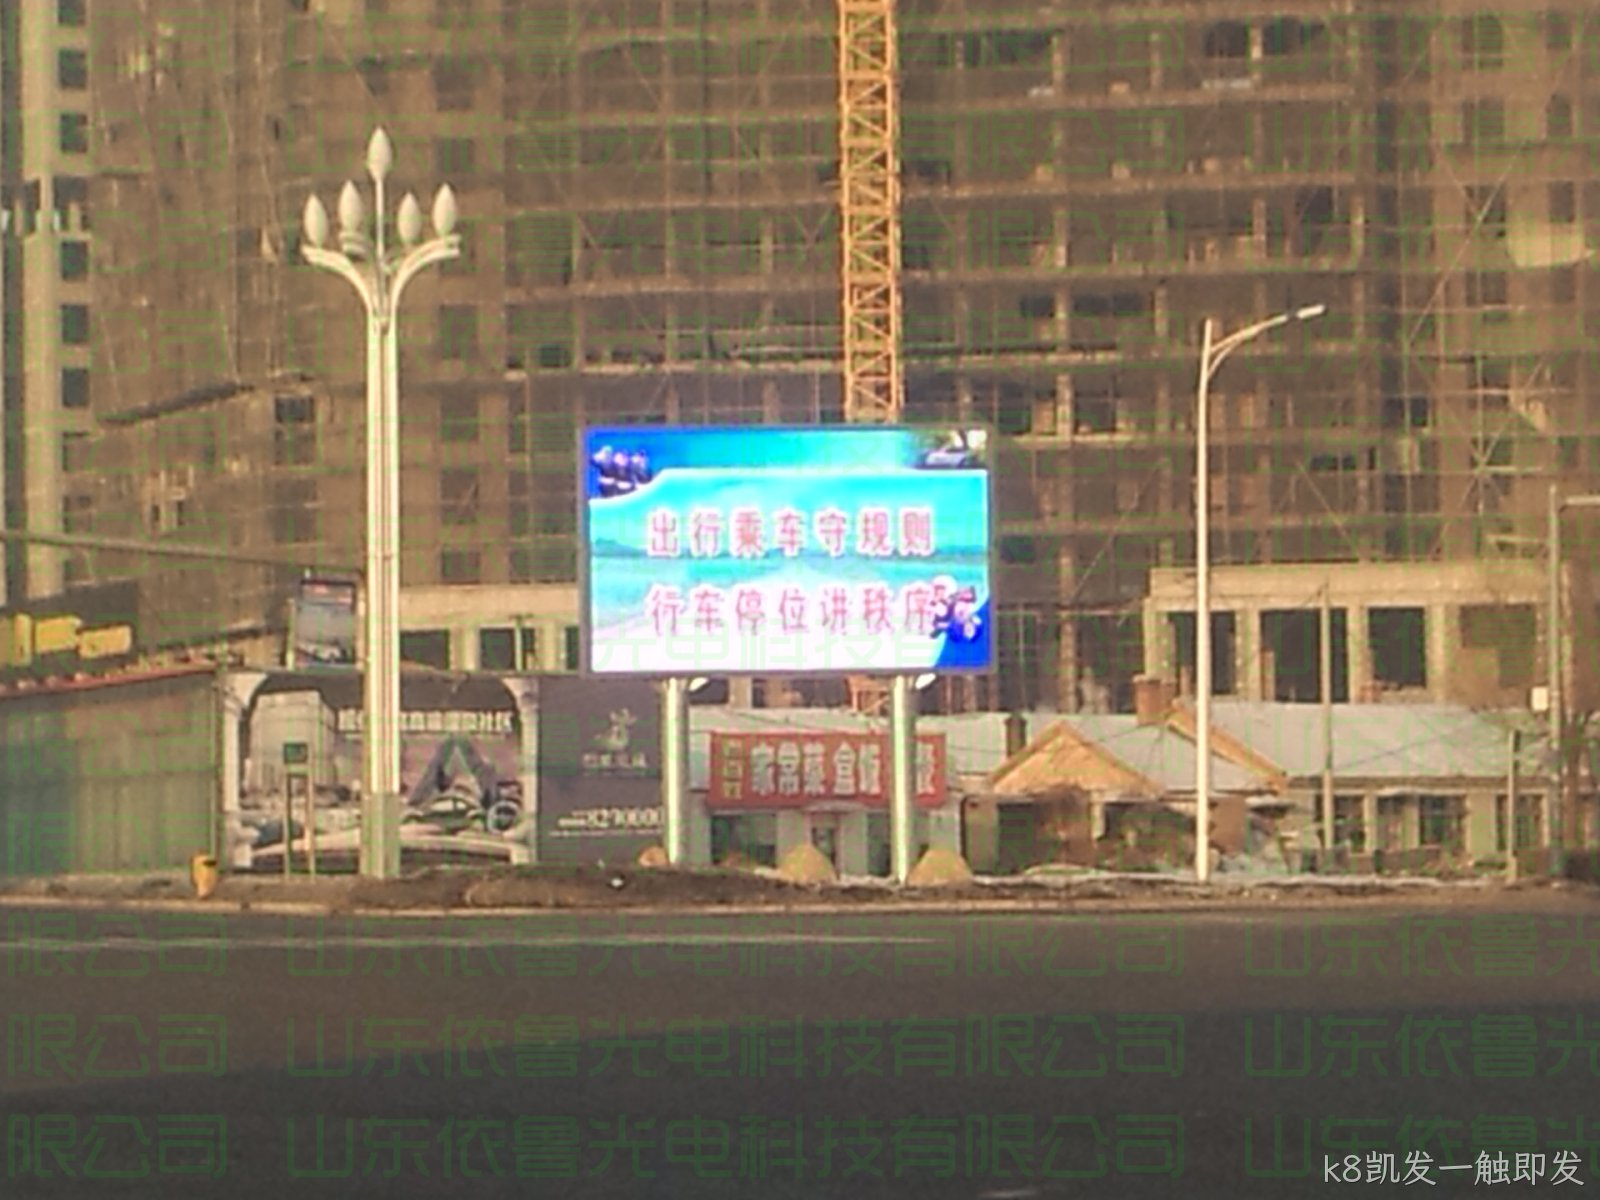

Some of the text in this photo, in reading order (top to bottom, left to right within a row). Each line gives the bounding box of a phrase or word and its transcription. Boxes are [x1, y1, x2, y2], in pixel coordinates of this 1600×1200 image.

[649, 508, 933, 556] 出行乘车守规则
[649, 585, 932, 636] 行车停位讲秩序
